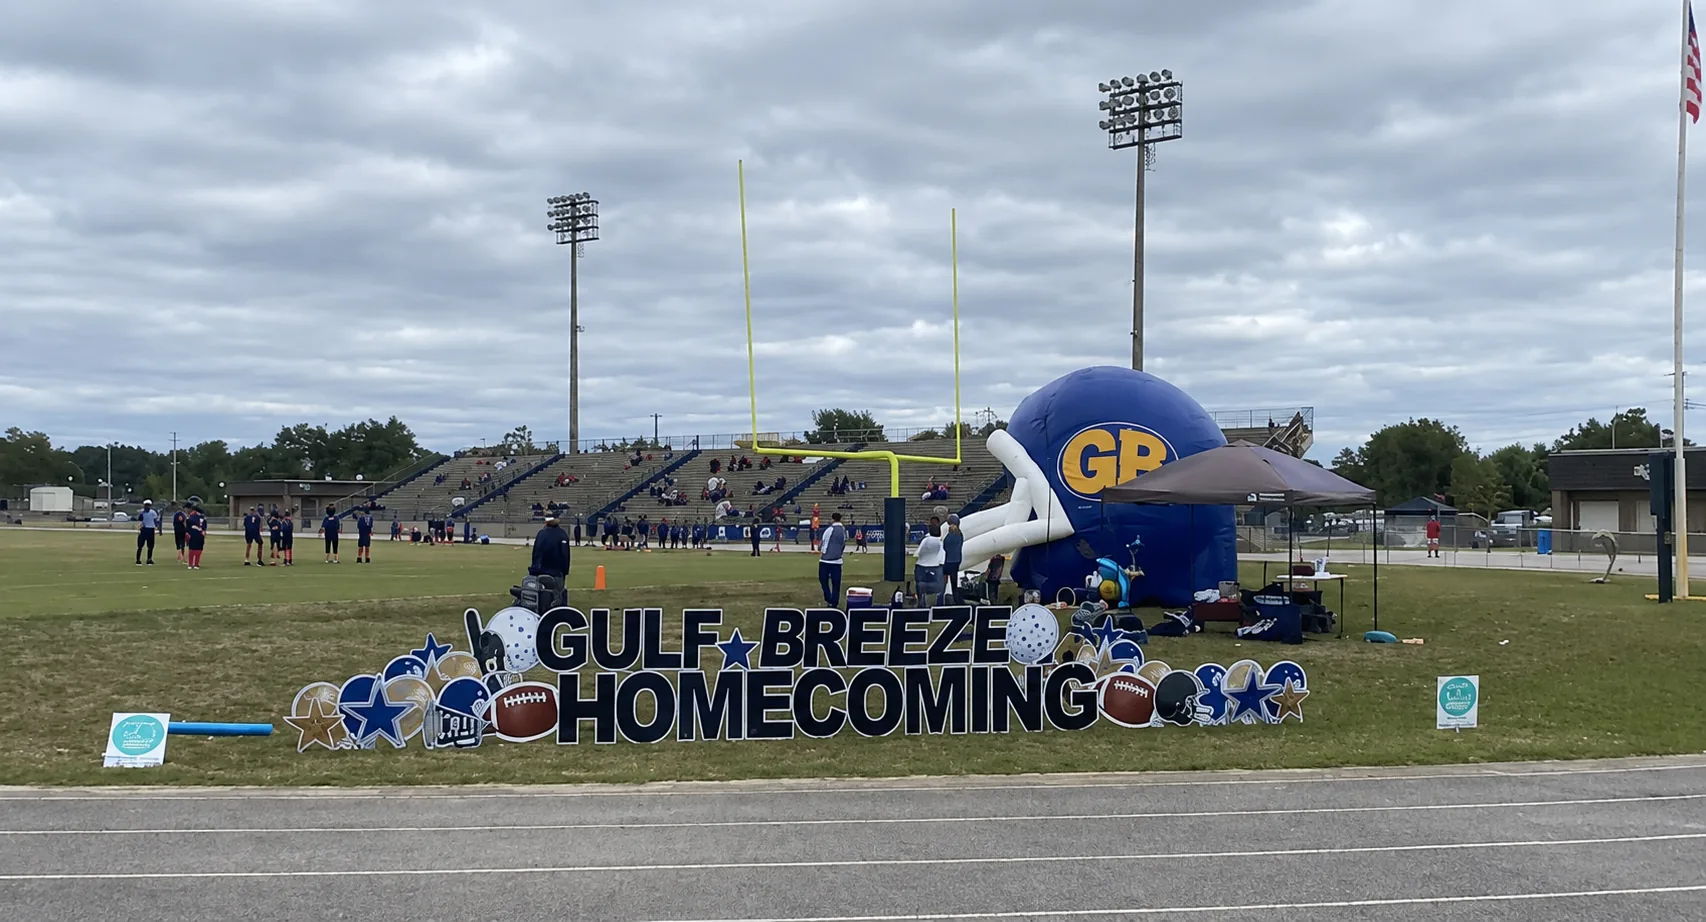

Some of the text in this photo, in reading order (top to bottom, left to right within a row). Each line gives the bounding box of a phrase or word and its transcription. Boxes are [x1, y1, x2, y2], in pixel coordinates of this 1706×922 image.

[1062, 428, 1167, 494] GB
[535, 605, 1013, 673] GULF BREEZE
[556, 661, 1099, 745] HOMECOMING
